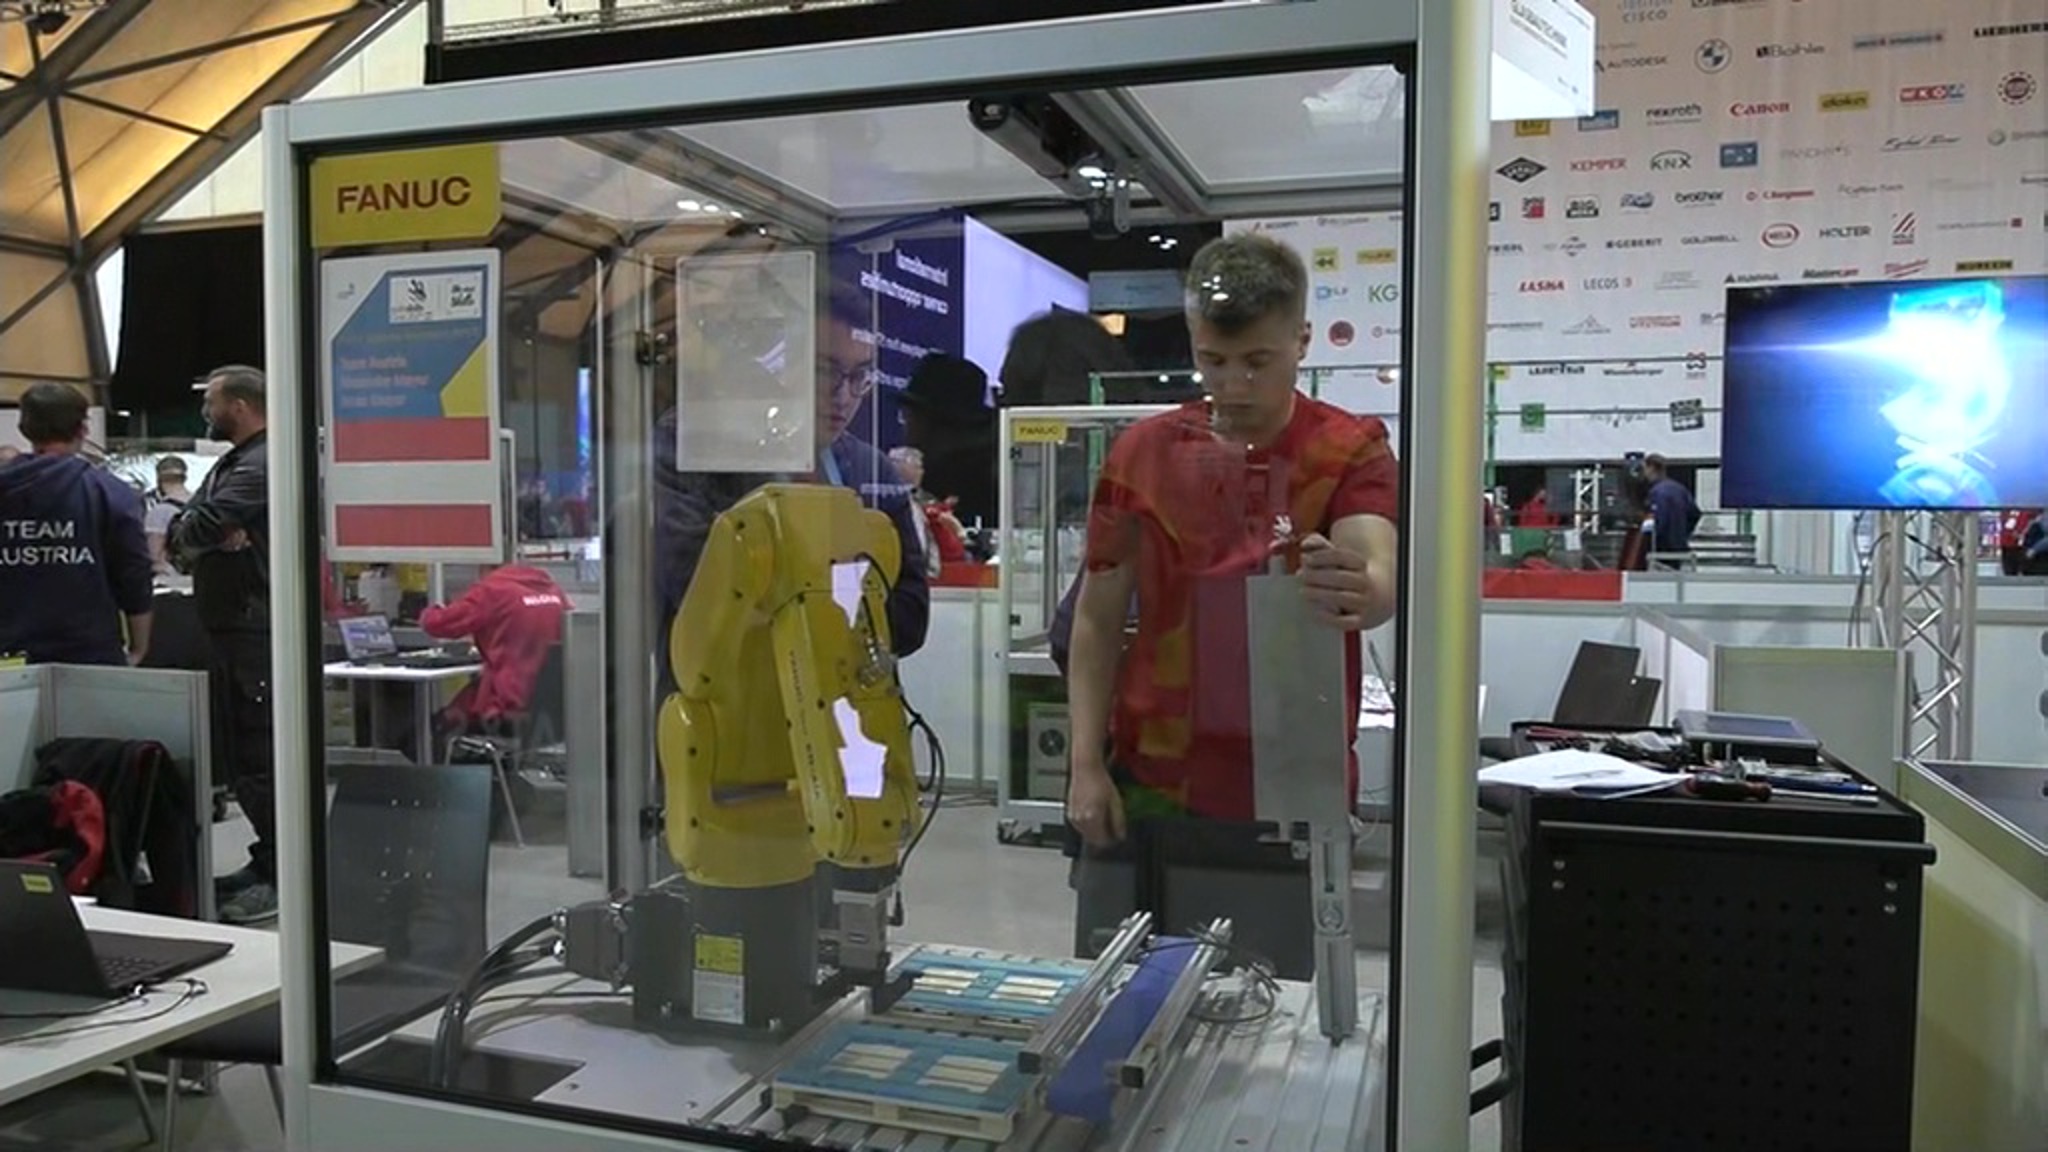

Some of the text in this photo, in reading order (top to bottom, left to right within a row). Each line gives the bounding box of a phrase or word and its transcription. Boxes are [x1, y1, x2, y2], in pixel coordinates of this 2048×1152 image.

[1622, 10, 1667, 23] CISCO
[1607, 56, 1668, 70] AUTODESK
[1646, 103, 1702, 118] rexroth
[1730, 102, 1791, 117] Canon
[1570, 158, 1627, 172] KEMPER
[1650, 153, 1691, 170] KNX
[337, 175, 472, 214] FANUC
[1674, 190, 1724, 203] brother
[1819, 225, 1871, 238] HOLTER
[1616, 237, 1663, 249] GEBERIT
[1583, 278, 1619, 290] LECOS
[1017, 425, 1060, 436] FANUC
[3, 520, 75, 539] TEAM
[0, 545, 95, 566] USTRIA
